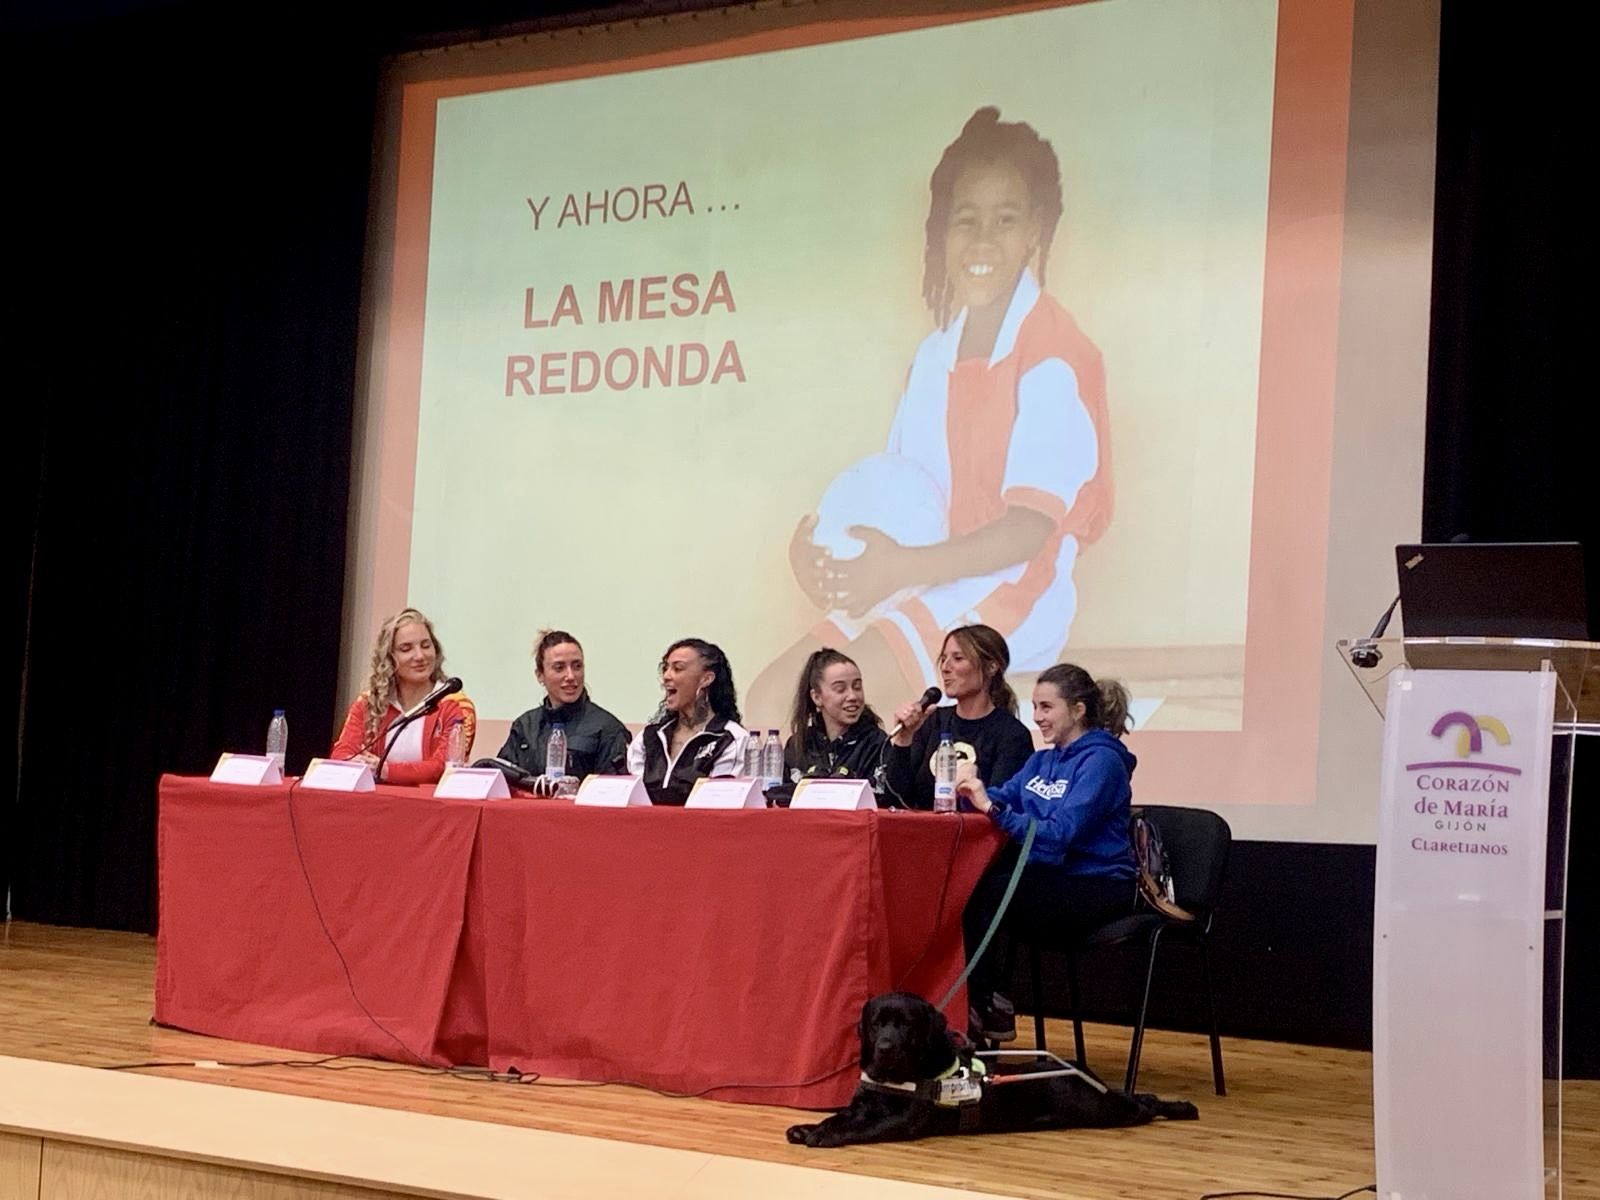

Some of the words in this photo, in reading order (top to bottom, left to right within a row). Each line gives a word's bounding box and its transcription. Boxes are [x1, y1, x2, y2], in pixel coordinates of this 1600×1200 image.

[527, 196, 550, 231] Y
[557, 180, 695, 229] AHORA
[524, 284, 584, 329] LA
[598, 270, 737, 324] MESA
[505, 340, 747, 397] REDONDA
[1414, 797, 1438, 815] de
[1434, 819, 1487, 832] GIJÓN
